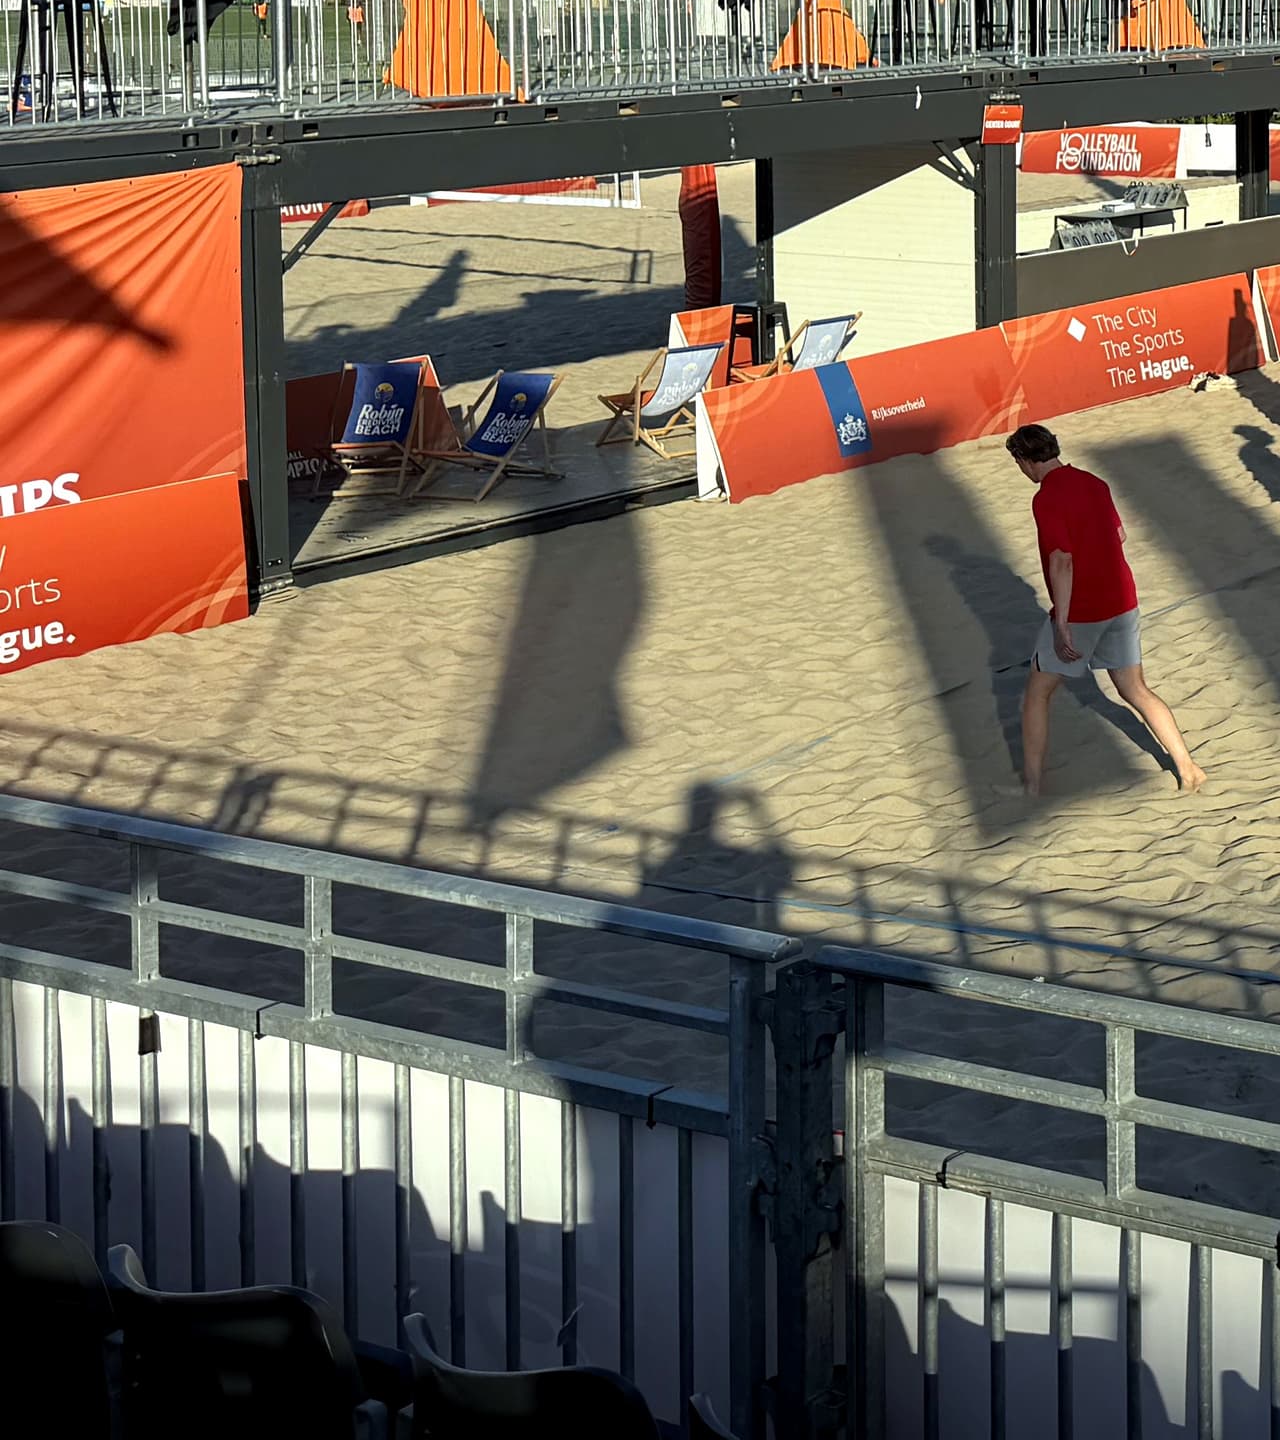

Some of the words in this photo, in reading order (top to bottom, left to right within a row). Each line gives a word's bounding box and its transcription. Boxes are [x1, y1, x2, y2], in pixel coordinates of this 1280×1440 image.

[1060, 133, 1138, 153] VOLLEYBALL
[1056, 152, 1142, 172] FOUNDATION
[1092, 314, 1124, 334] The
[1126, 306, 1157, 328] City
[1100, 340, 1131, 360] The
[1133, 328, 1184, 356] Sports
[1106, 366, 1136, 388] The
[1140, 355, 1194, 380] Hague.
[872, 396, 926, 421] Rijksoverheid
[355, 424, 400, 436] BEACH
